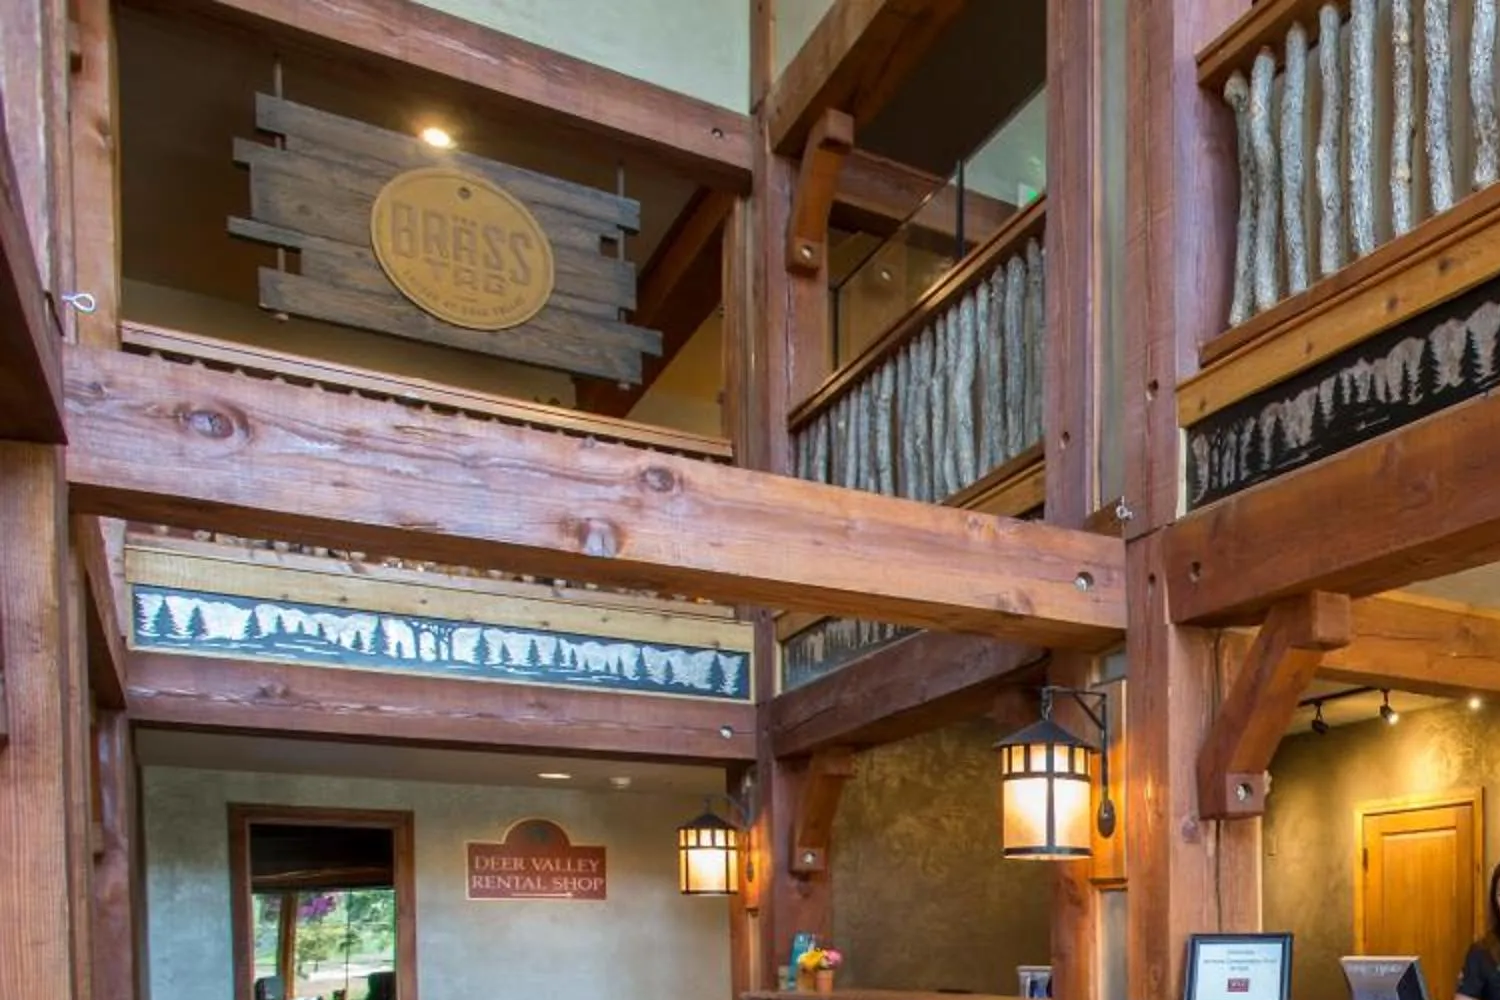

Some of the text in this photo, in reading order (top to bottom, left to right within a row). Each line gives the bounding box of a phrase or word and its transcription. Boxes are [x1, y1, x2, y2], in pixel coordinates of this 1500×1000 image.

[390, 202, 533, 286] BRASS
[474, 855, 600, 873] DEER VALLEY
[471, 875, 604, 891] RENTAL SHOP
